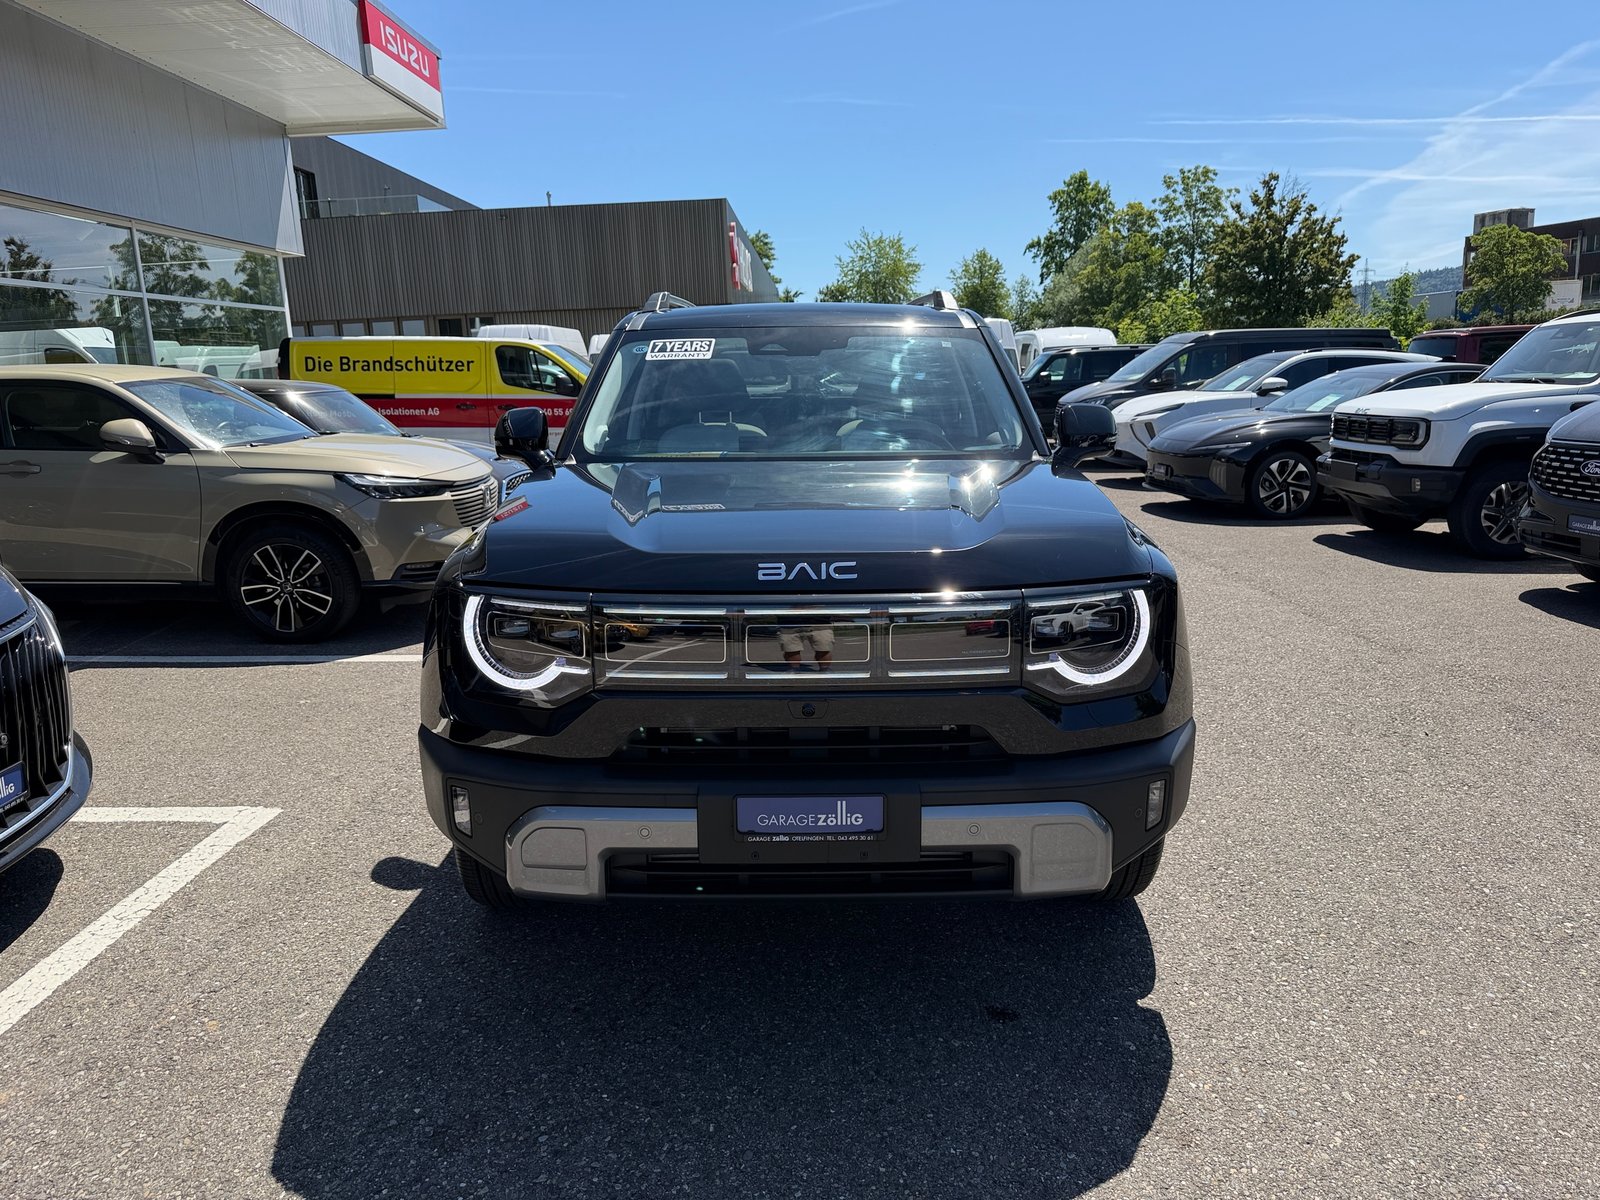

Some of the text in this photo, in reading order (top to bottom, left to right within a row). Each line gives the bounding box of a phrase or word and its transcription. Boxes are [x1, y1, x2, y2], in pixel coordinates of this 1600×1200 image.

[379, 20, 430, 78] ISUZU
[653, 341, 710, 352] 7 YEARS
[304, 355, 475, 372] Die Brandschützer
[378, 407, 426, 416] Isolationen
[427, 407, 440, 416] AG
[553, 407, 564, 416] 55
[757, 561, 858, 580] BAIC
[757, 814, 815, 826] GARAGE
